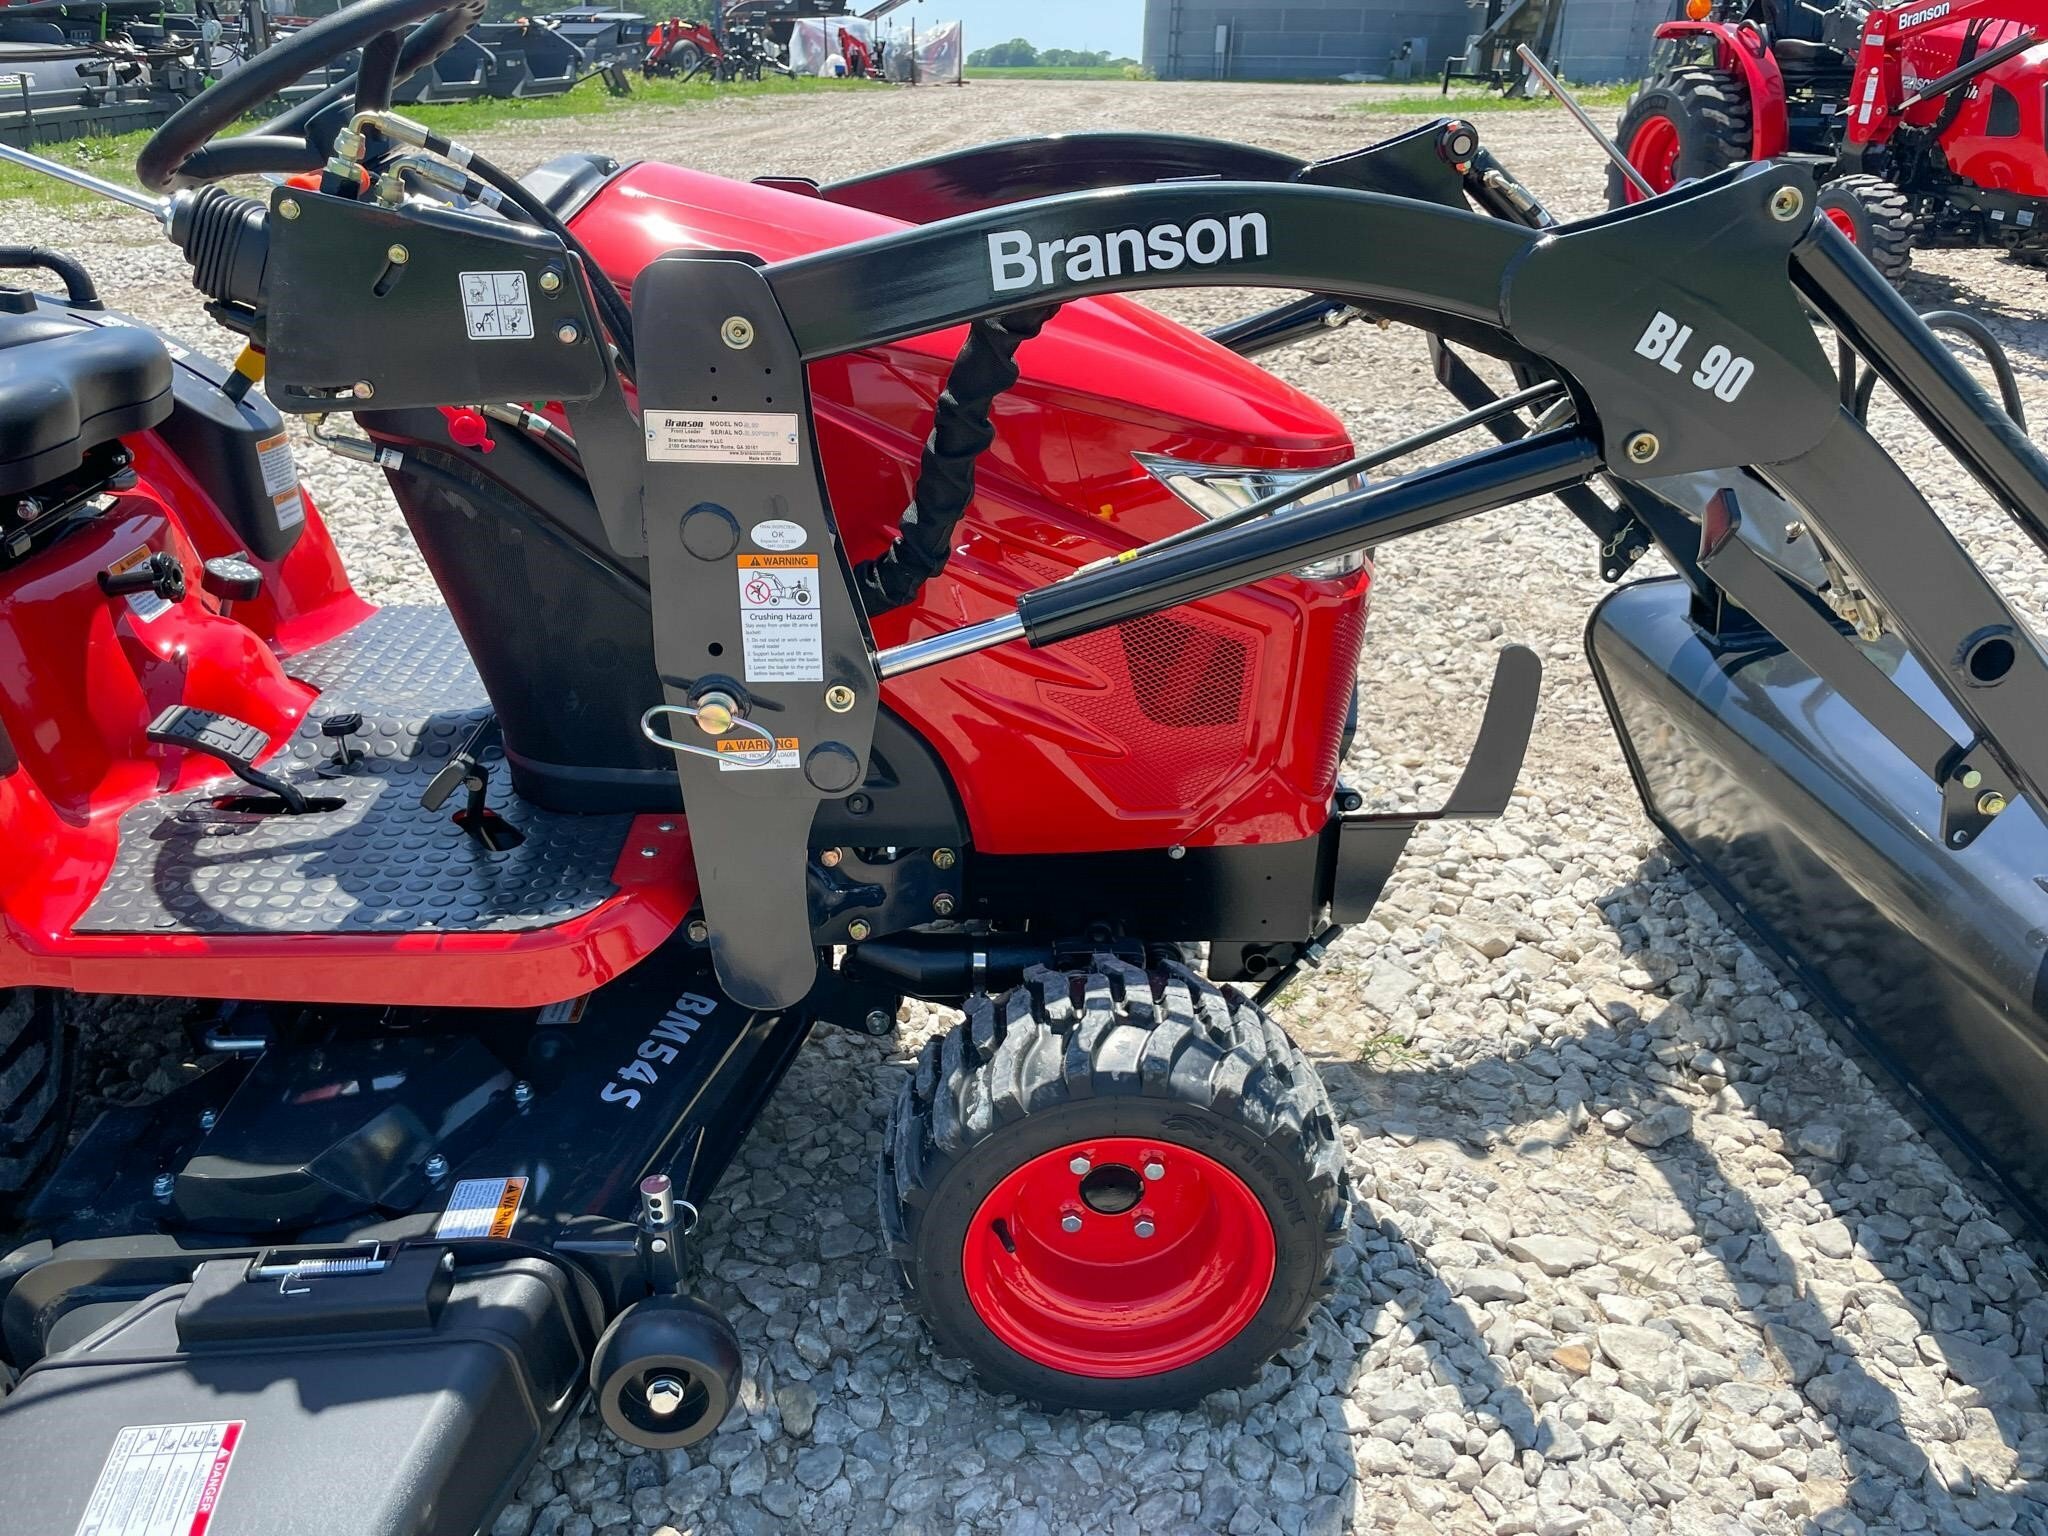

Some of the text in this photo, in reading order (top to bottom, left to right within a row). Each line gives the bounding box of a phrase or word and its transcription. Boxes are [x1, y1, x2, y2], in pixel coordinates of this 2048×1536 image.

[1898, 2, 1950, 30] Branson
[987, 212, 1268, 291] Branson
[1634, 311, 1754, 403] BL 90
[664, 418, 704, 428] Branson
[771, 530, 784, 538] OK
[763, 556, 808, 566] WARNING
[749, 612, 813, 621] Crushing Hazard
[735, 739, 793, 750] WARNNG
[601, 992, 718, 1109] BM54S
[493, 1195, 515, 1236] WARNIN
[198, 1462, 226, 1512] DANGER
